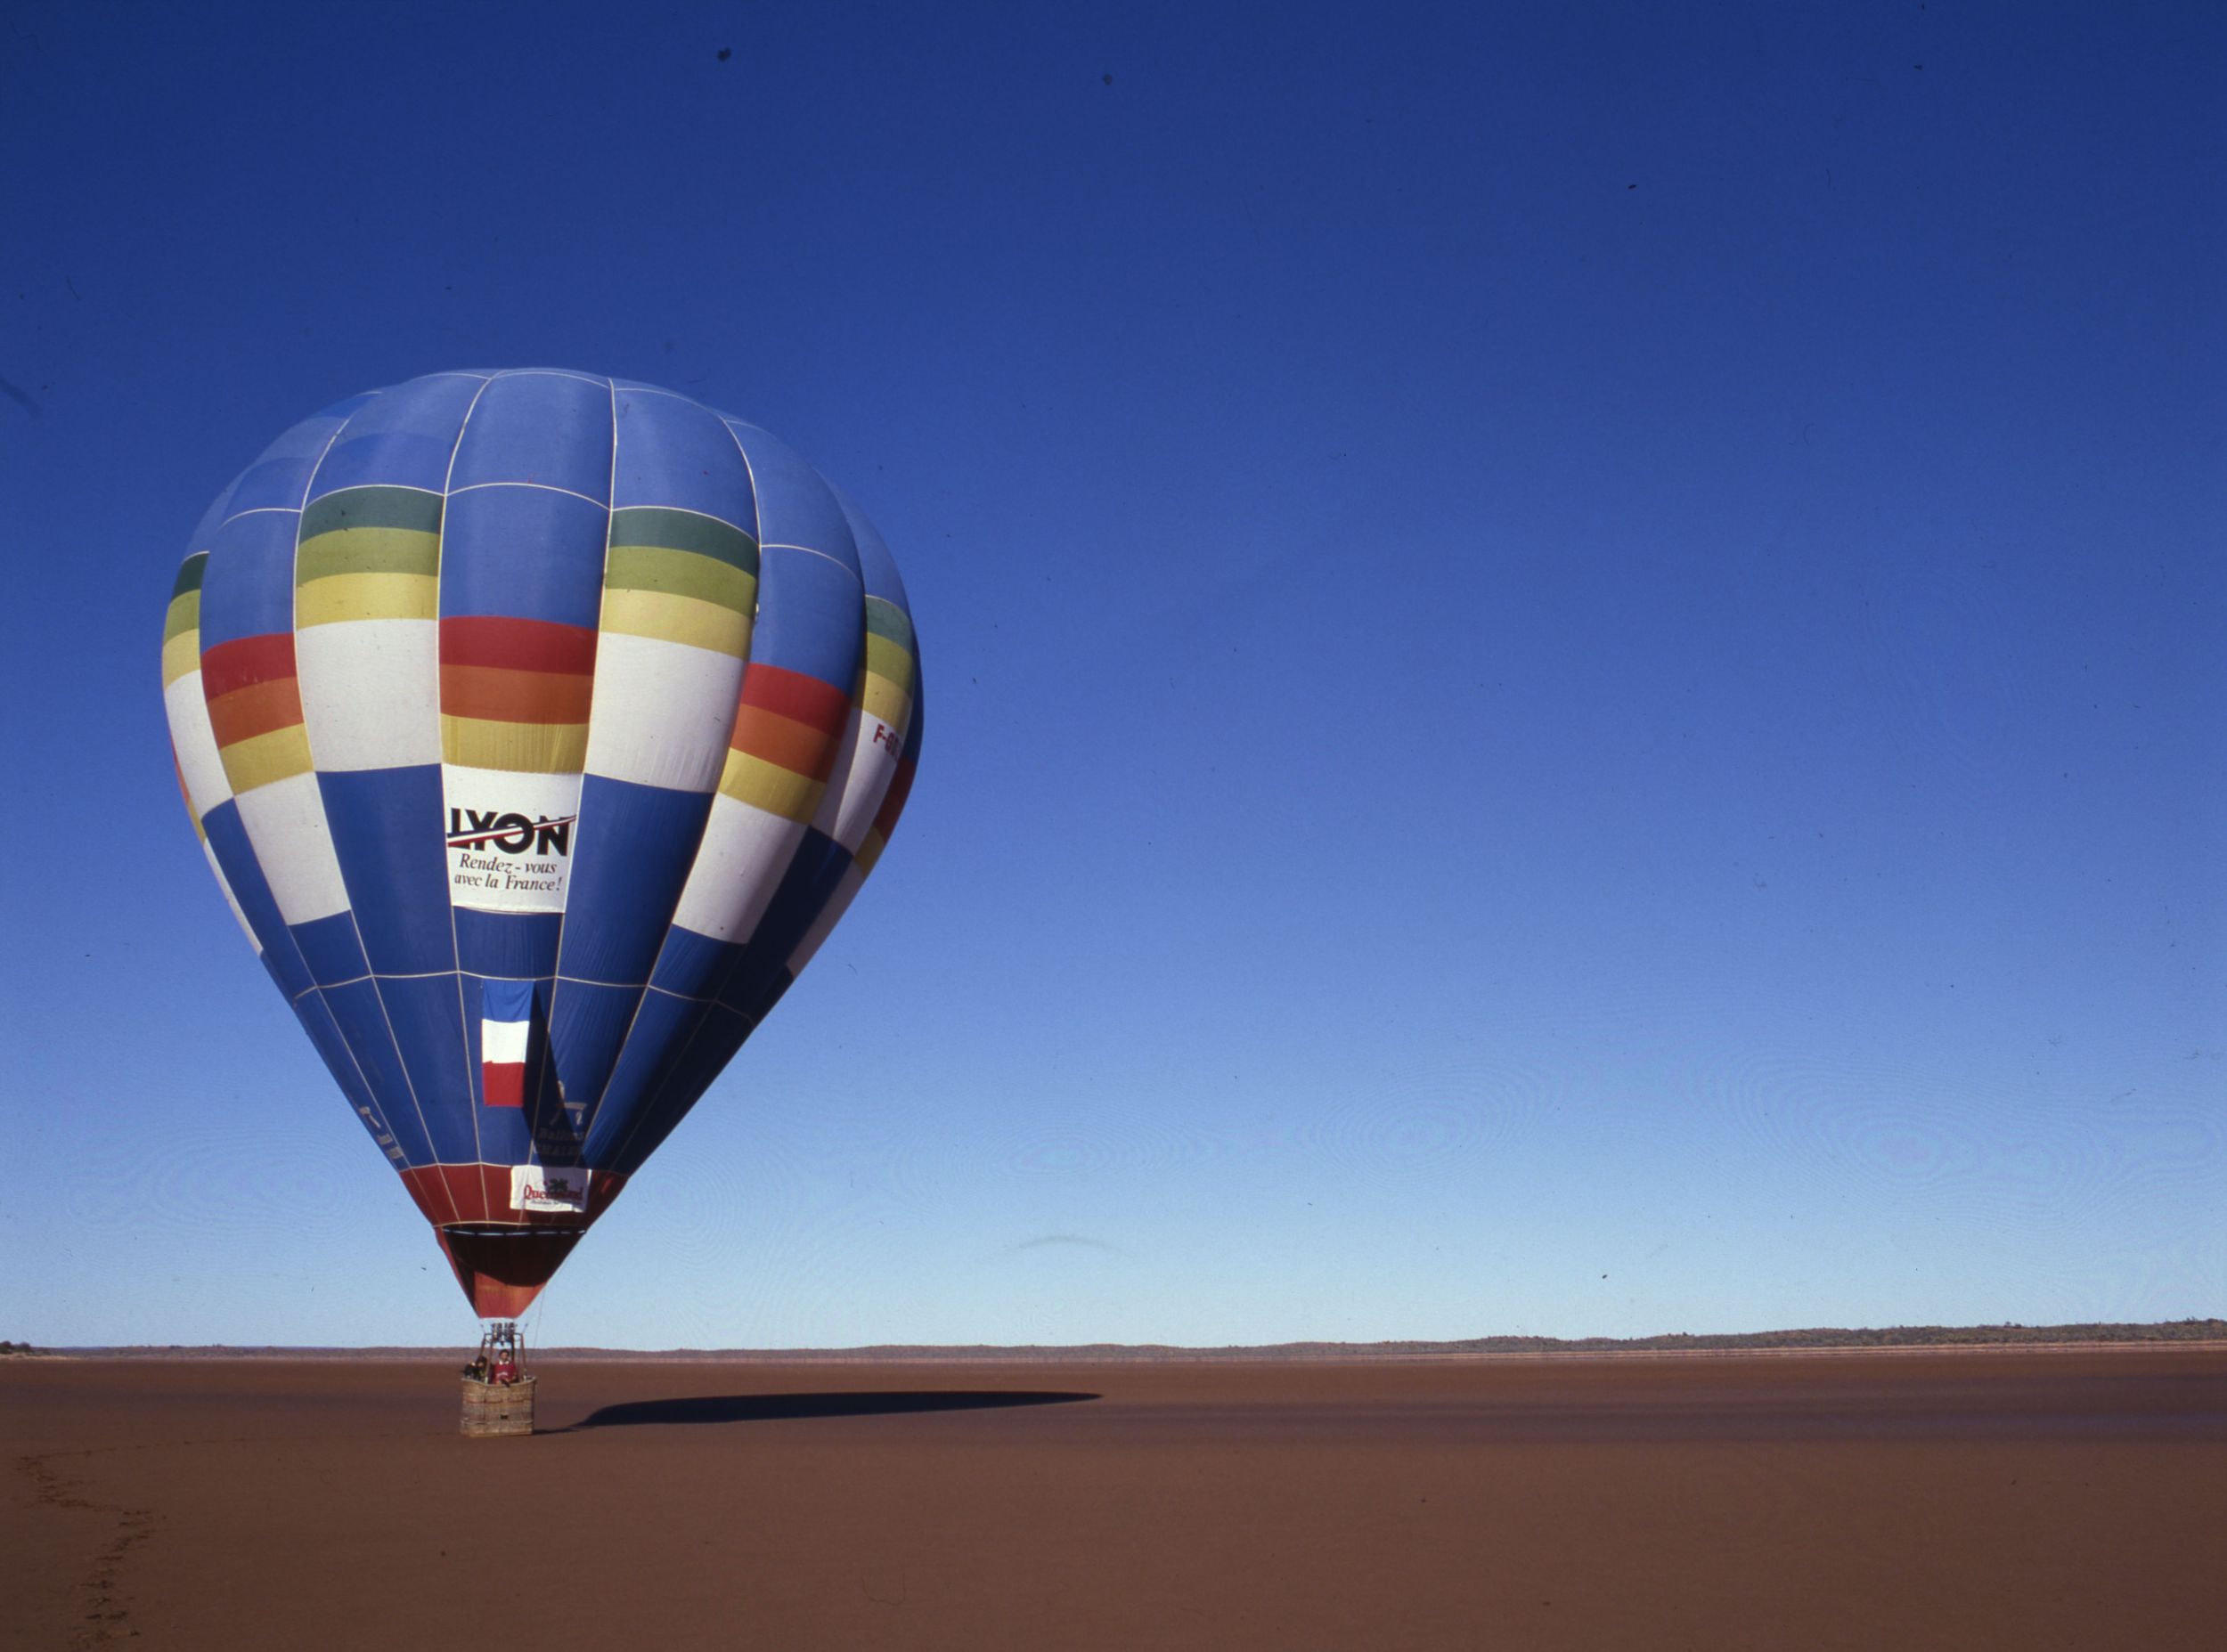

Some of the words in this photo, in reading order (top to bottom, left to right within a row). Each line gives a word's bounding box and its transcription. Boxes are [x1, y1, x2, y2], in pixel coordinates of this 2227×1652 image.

[447, 808, 573, 856] LYON
[454, 873, 482, 887] avec
[485, 874, 499, 889] la
[505, 875, 562, 891] France!
[524, 1184, 583, 1200] Queeand
